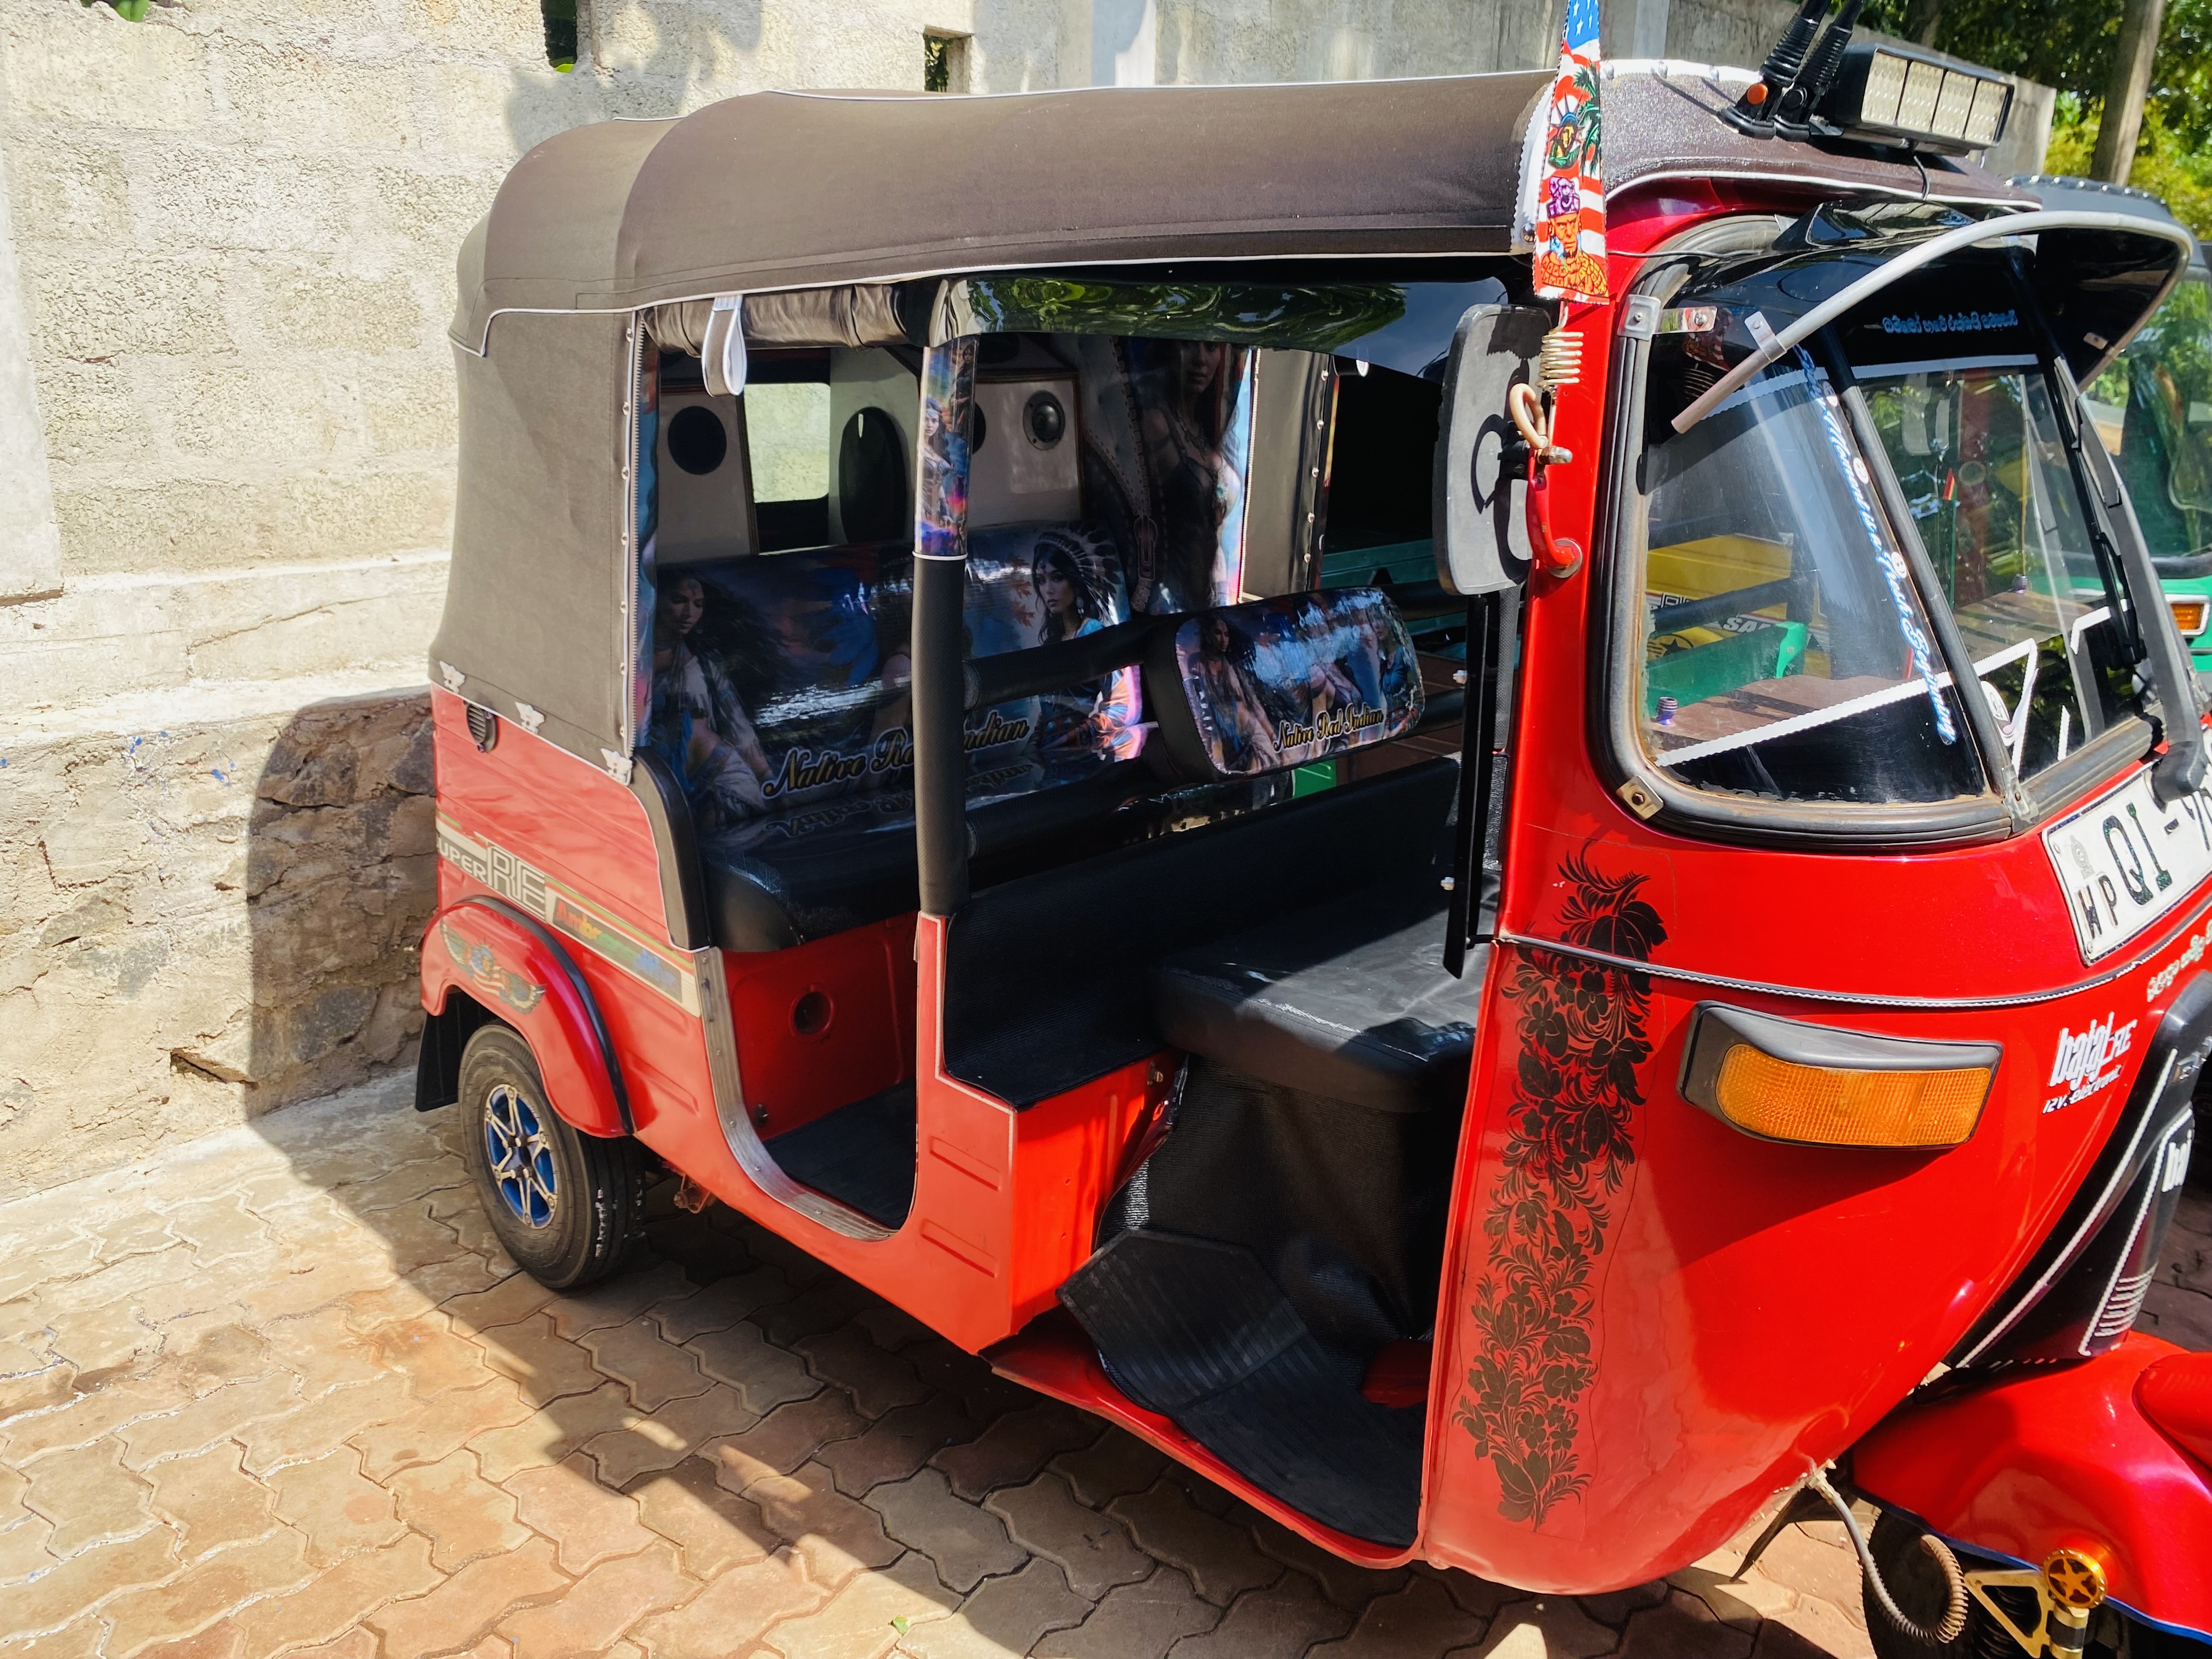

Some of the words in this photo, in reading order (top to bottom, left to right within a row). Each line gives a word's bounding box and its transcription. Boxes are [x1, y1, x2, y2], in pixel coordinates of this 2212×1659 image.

[762, 747, 867, 798] Native
[964, 709, 1031, 751] ndian
[1273, 719, 1315, 753] Native
[1343, 702, 1385, 733] Indian
[2076, 874, 2119, 939] WP
[2049, 1011, 2114, 1091] bajaj
